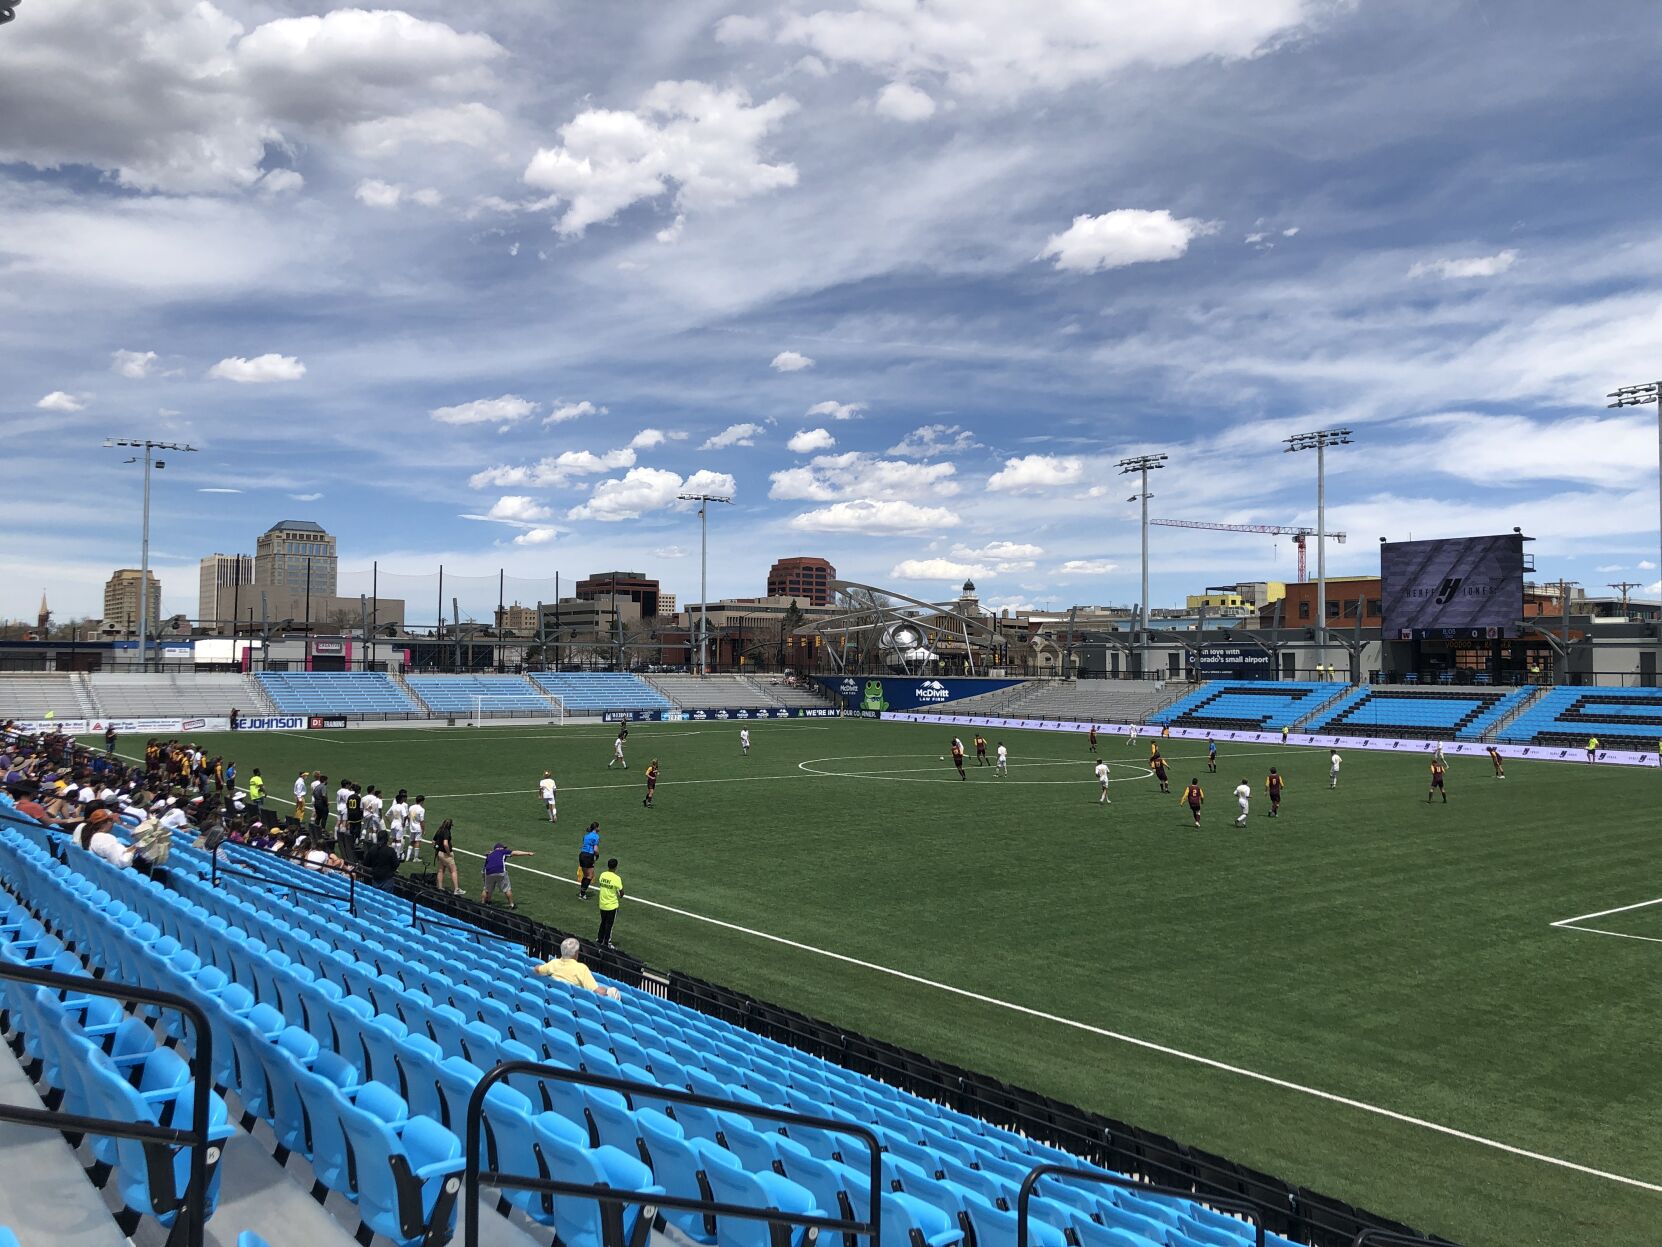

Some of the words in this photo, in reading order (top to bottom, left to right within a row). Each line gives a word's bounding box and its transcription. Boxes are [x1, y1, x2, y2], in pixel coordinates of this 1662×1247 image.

[1471, 630, 1478, 638] 0
[1189, 655, 1225, 663] Corado's
[1244, 656, 1269, 664] airport
[915, 689, 949, 697] McDivitt
[247, 717, 303, 729] JOHNSON
